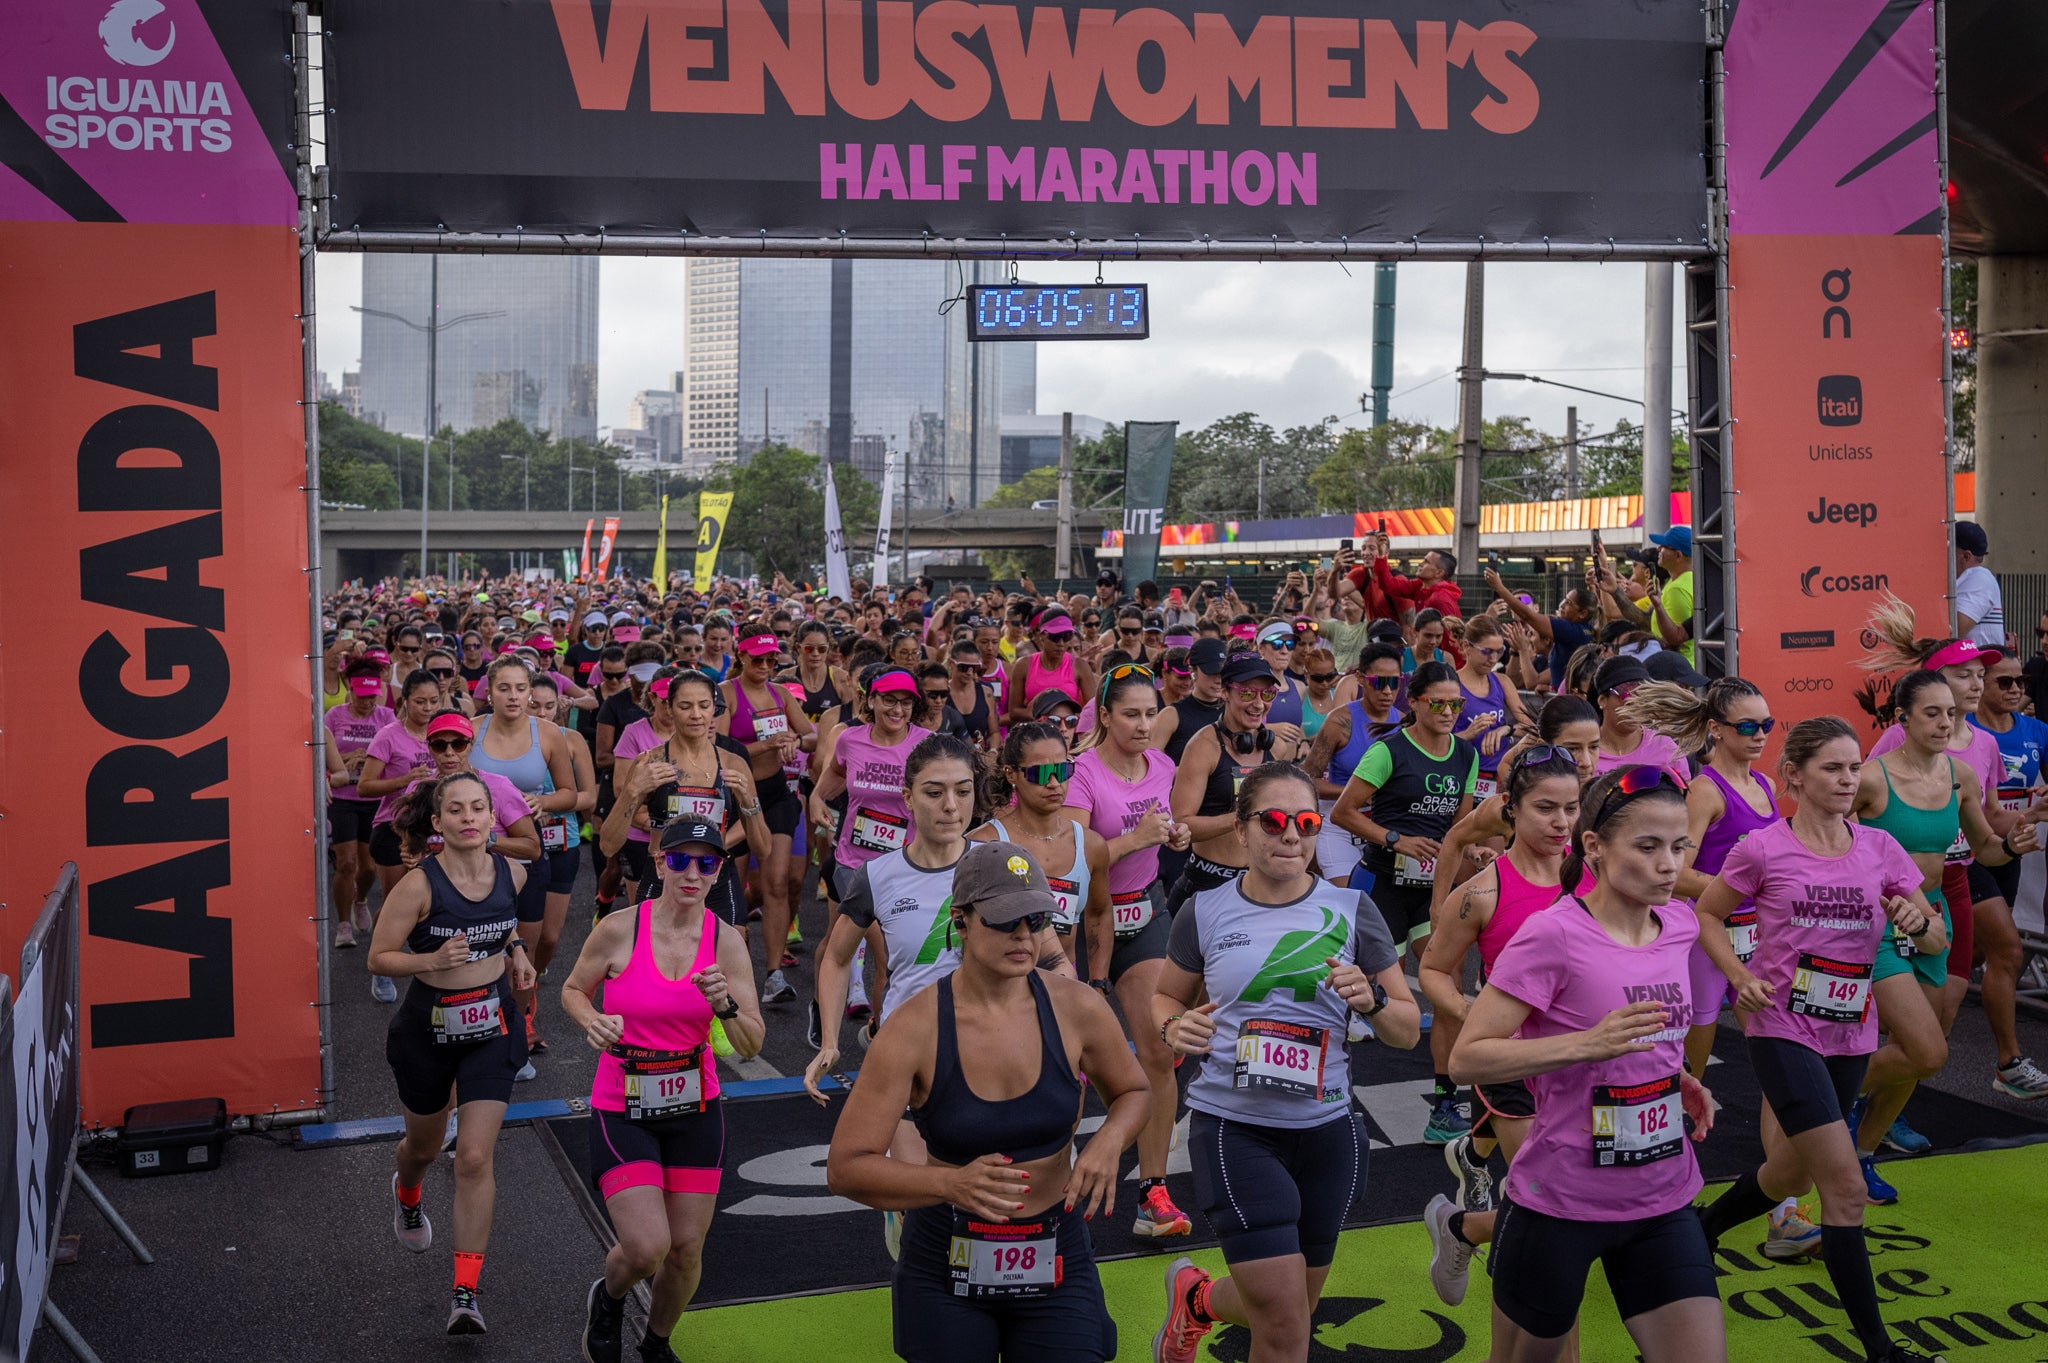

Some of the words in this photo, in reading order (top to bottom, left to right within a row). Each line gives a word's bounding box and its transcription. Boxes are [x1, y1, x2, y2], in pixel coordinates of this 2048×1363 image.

[46, 76, 231, 115] IGUANA
[45, 115, 232, 152] SPORTS
[820, 143, 976, 200] HALF
[987, 146, 1317, 206] MARATHON
[1809, 444, 1872, 460] Uniclass
[1808, 497, 1877, 528] Jeep
[1822, 574, 1888, 592] cosan
[73, 290, 235, 1048] LARGADA
[1785, 677, 1833, 692] dobro
[768, 718, 783, 729] 206
[865, 762, 902, 775] VENUS
[853, 781, 868, 789] HALF
[870, 783, 902, 793] MARATHO
[856, 771, 905, 785] WOMEN'
[692, 800, 714, 815] 157
[1423, 796, 1459, 806] GRAZI
[873, 825, 895, 840] 194
[1196, 860, 1236, 878] NIKE
[1804, 885, 1865, 904] VENUS
[1116, 906, 1141, 923] 170
[1791, 901, 1874, 920] WOMEN'S
[430, 926, 462, 937] IBIRA
[1790, 916, 1816, 928] HALF
[1819, 919, 1871, 930] MARATHON
[1622, 982, 1683, 1005] VENUS
[1828, 981, 1858, 1001] 149
[460, 1005, 489, 1025] 184
[1263, 1042, 1309, 1071] 1683
[658, 1076, 686, 1097] 119
[1638, 1103, 1668, 1135] 182
[139, 1153, 154, 1164] 33
[968, 1221, 1042, 1234] VENUSWOMEN'S
[955, 1242, 965, 1262] A
[993, 1246, 1036, 1272] 198
